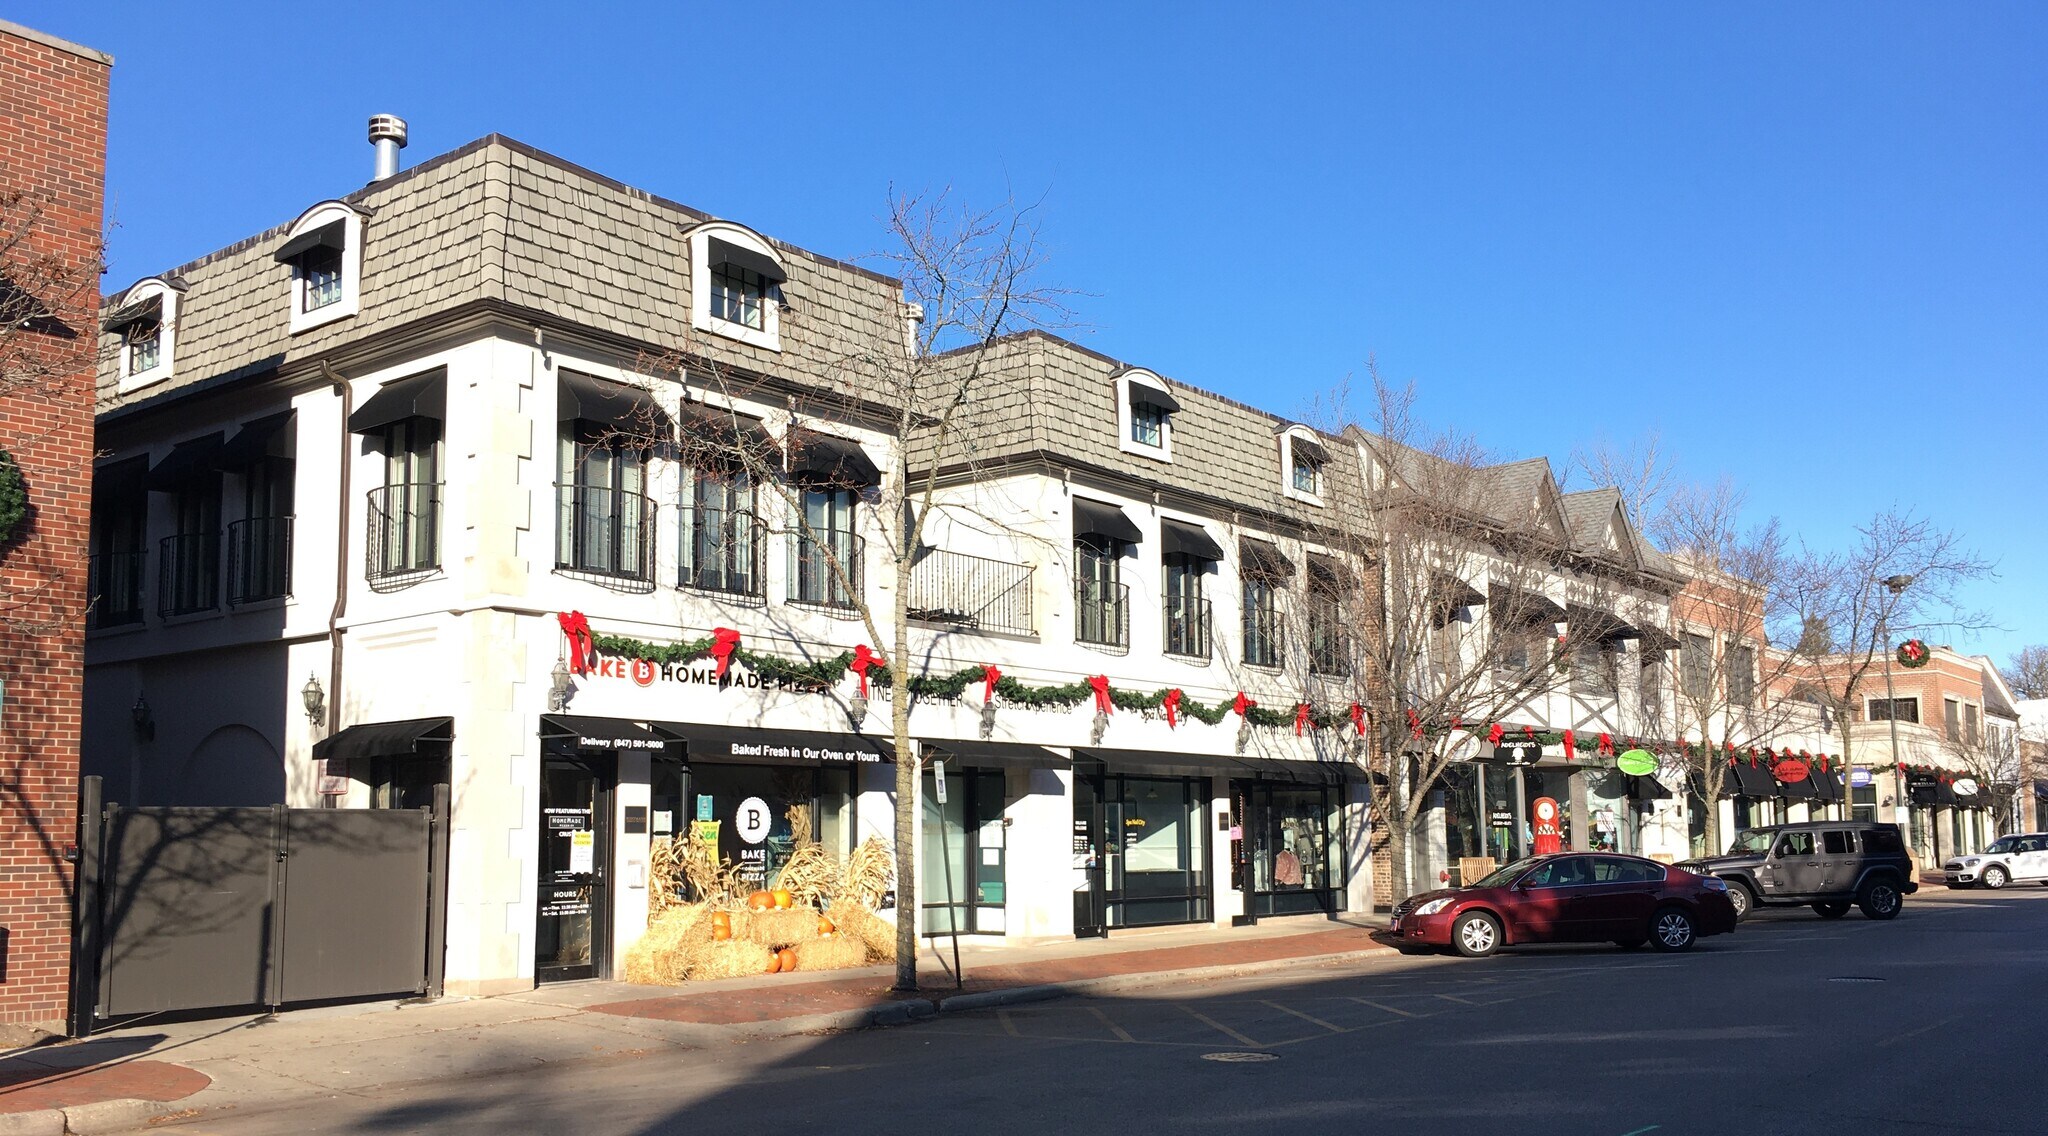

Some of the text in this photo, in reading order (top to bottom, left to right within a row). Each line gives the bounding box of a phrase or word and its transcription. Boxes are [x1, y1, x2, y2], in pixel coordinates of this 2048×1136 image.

[661, 664, 771, 690] HOMEMADE
[581, 737, 611, 748] Delivery
[614, 739, 632, 749] (847)
[731, 743, 880, 762] Baked Fresh in Our Oven or Yours
[747, 809, 760, 830] B
[741, 849, 766, 860] BAKE
[741, 872, 766, 881] PIZZA
